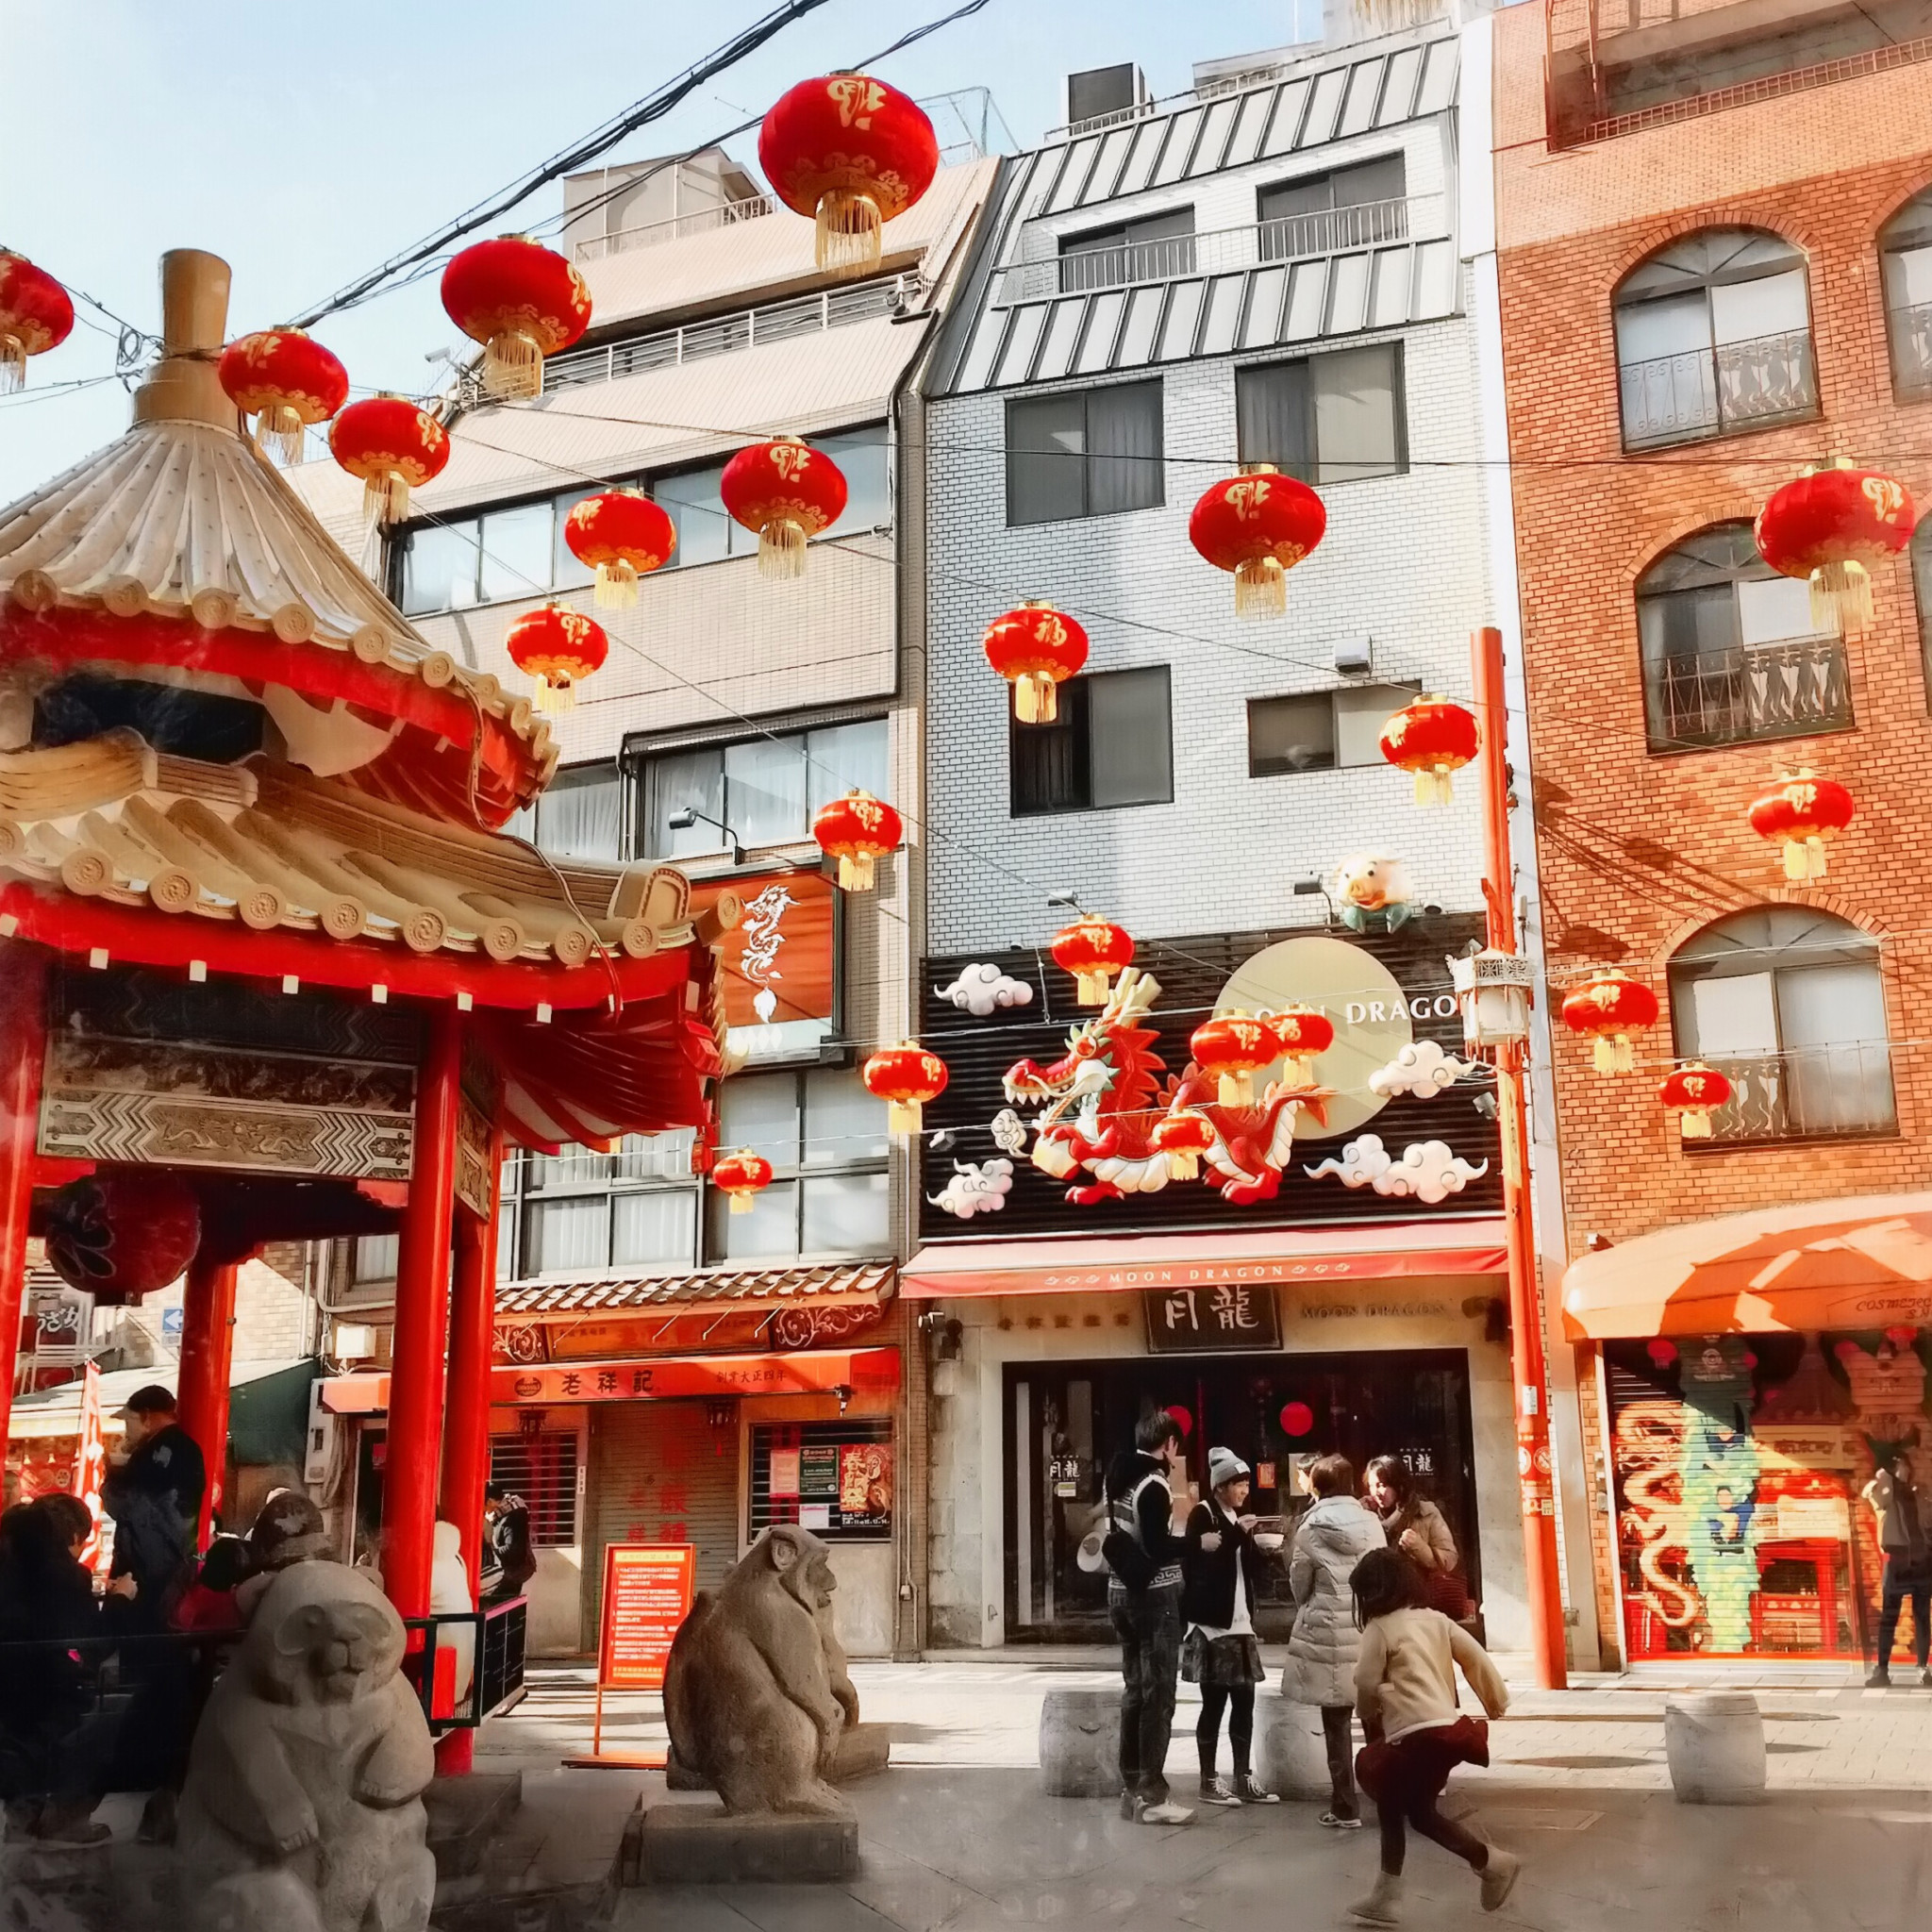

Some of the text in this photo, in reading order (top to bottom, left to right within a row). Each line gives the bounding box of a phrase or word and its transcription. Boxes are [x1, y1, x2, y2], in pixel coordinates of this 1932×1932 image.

[1034, 614, 1067, 645] 福
[1346, 995, 1457, 1024] DRAGO
[1108, 1265, 1283, 1284] MOON DRAGON
[1164, 1286, 1259, 1330] 月龍
[1302, 1303, 1447, 1319] MOON DRAGON
[561, 1370, 654, 1396] 老祥記
[1050, 1460, 1080, 1478] 月龍
